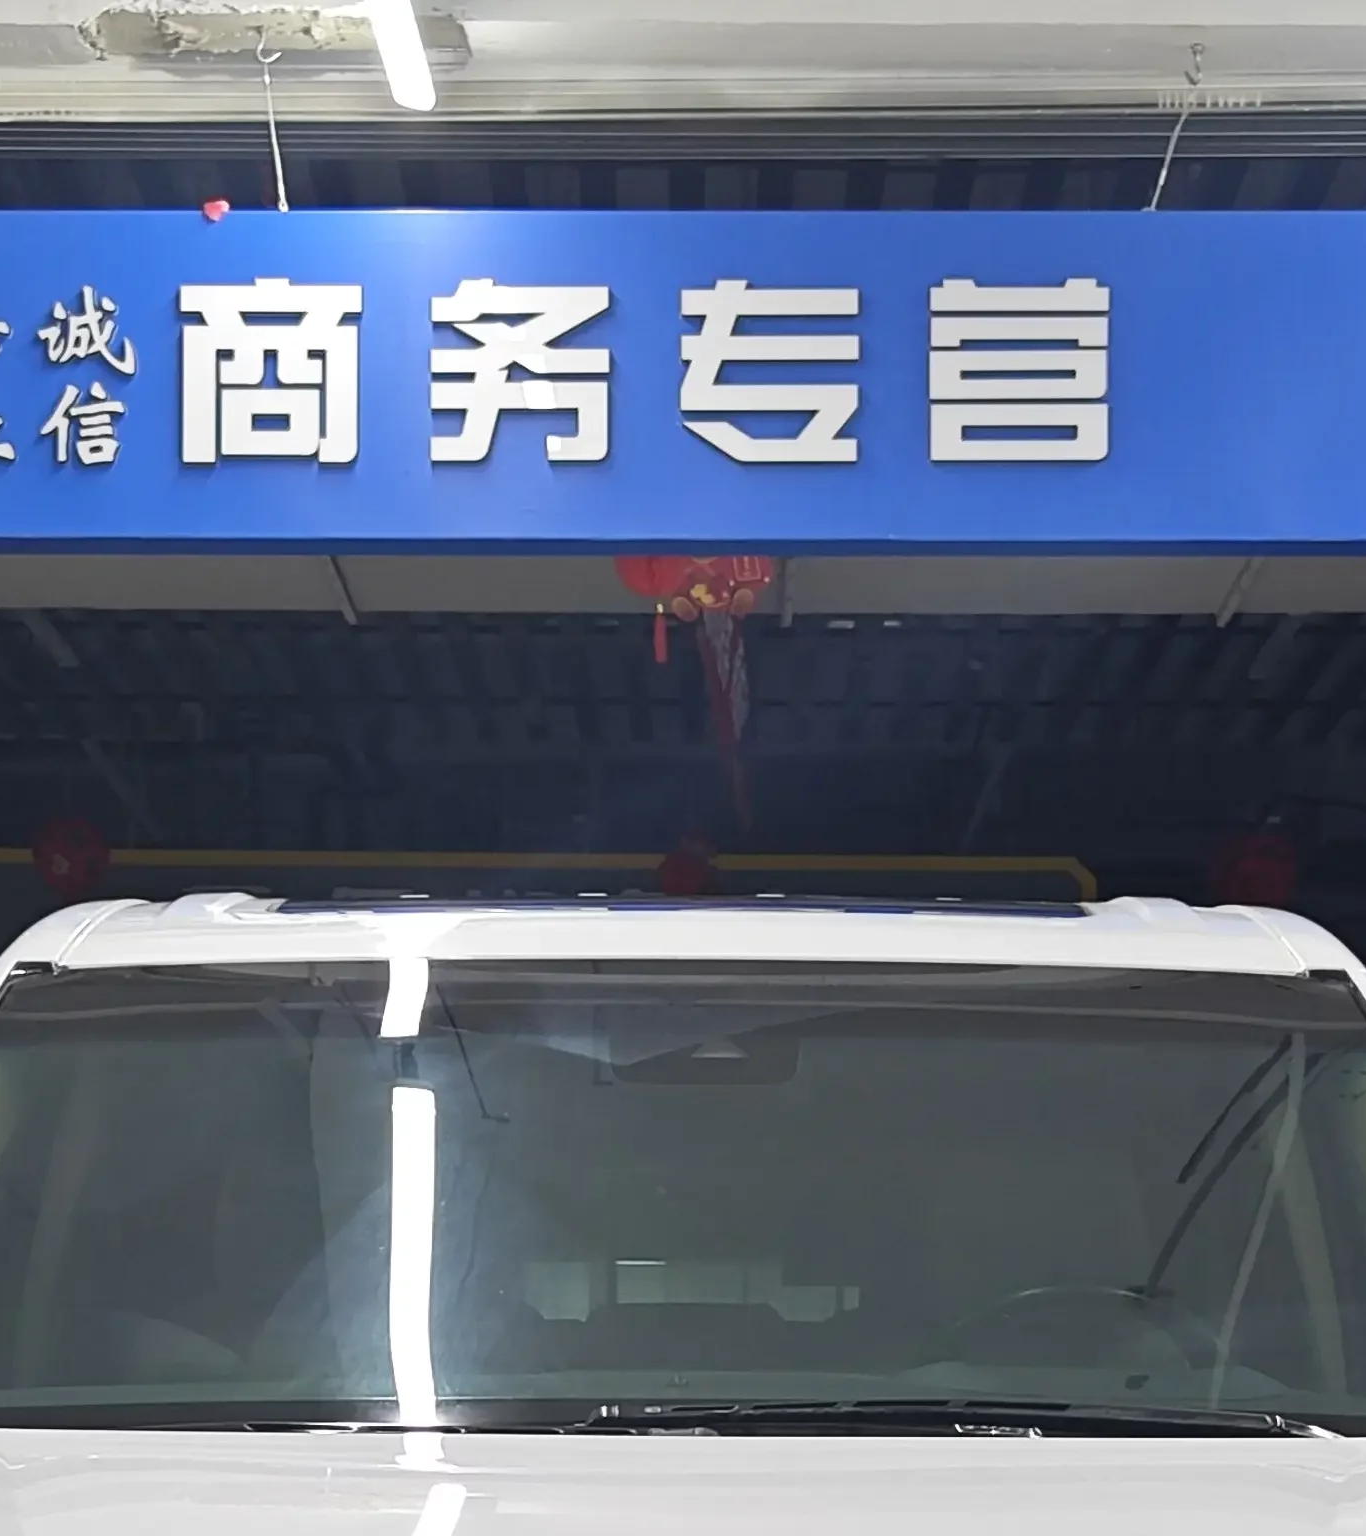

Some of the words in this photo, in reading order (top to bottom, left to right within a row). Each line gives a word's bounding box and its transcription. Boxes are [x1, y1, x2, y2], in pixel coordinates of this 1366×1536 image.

[39, 287, 135, 464] 诚信
[180, 278, 1109, 462] 商务专营
